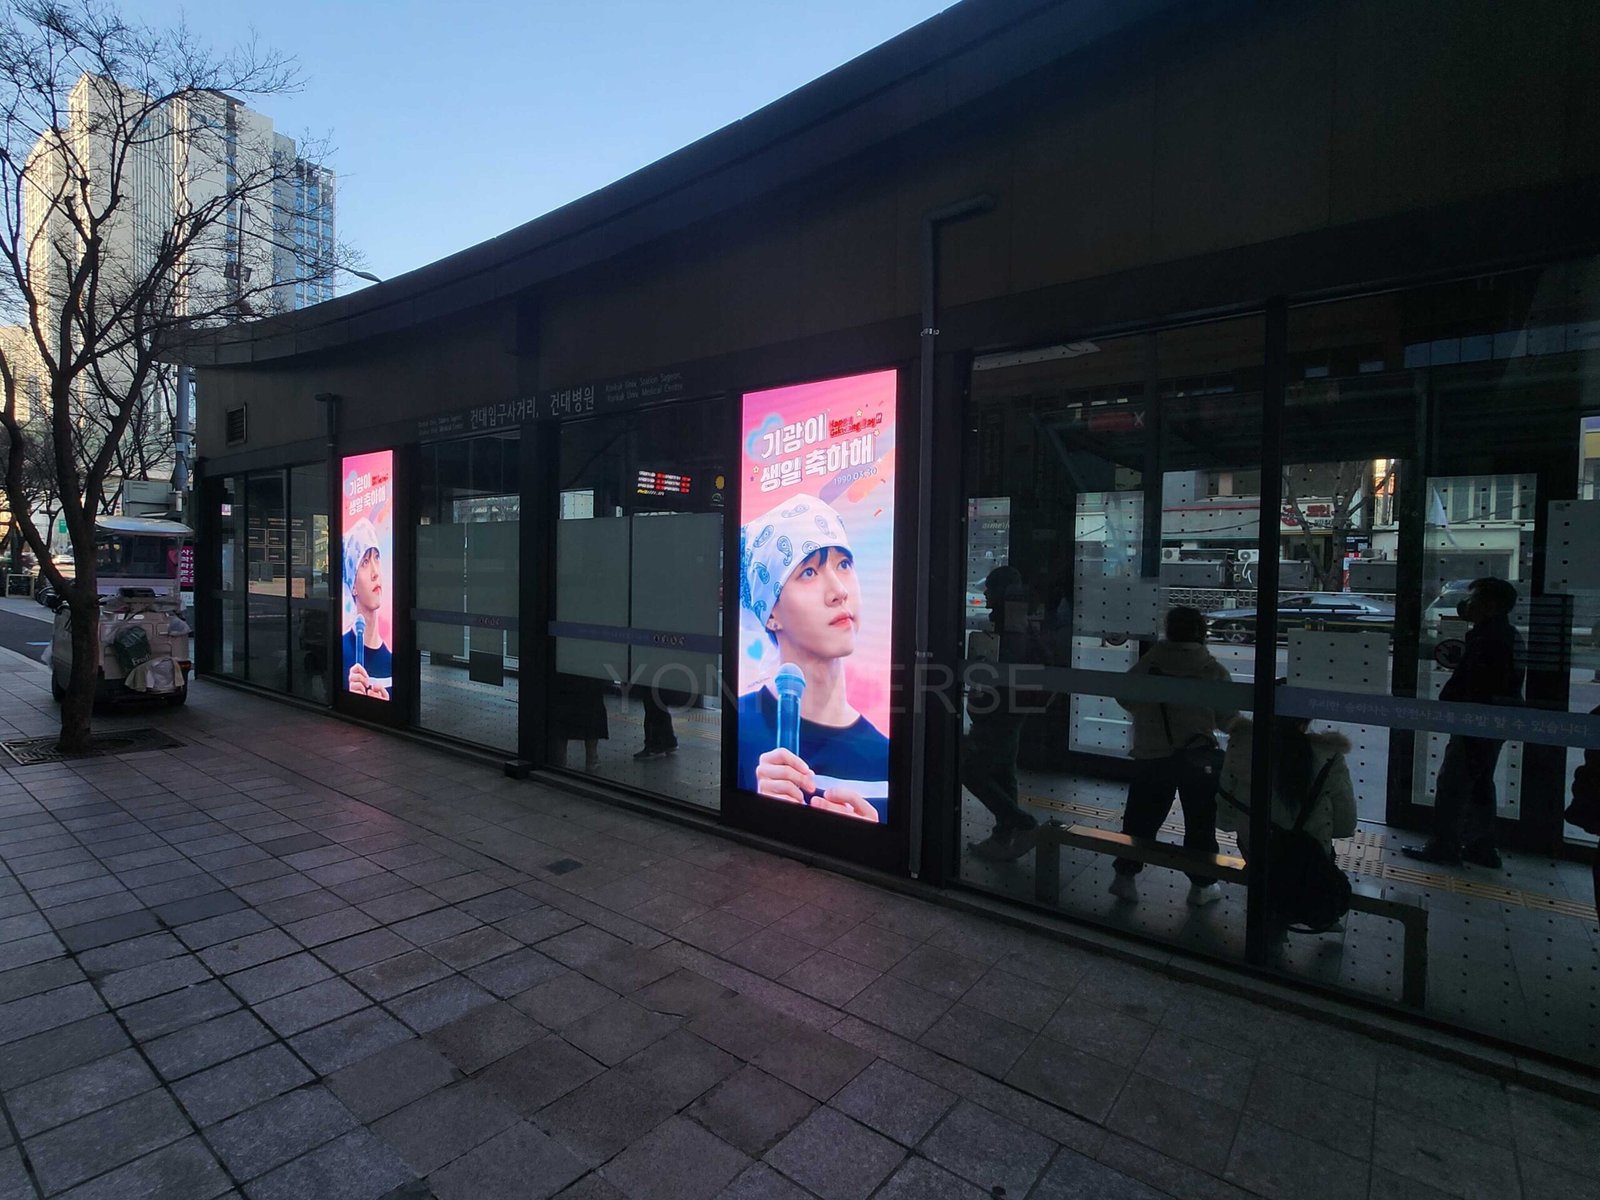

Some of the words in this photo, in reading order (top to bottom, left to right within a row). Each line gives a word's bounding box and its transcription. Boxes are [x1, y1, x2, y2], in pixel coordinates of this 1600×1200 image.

[550, 385, 595, 416] 건대병원
[761, 412, 828, 459] 기광이
[760, 456, 803, 493] 생일
[805, 433, 876, 476] 축하해
[1463, 712, 1490, 727] 유발
[1512, 719, 1526, 730] 수
[1531, 719, 1590, 736] 있습니다
